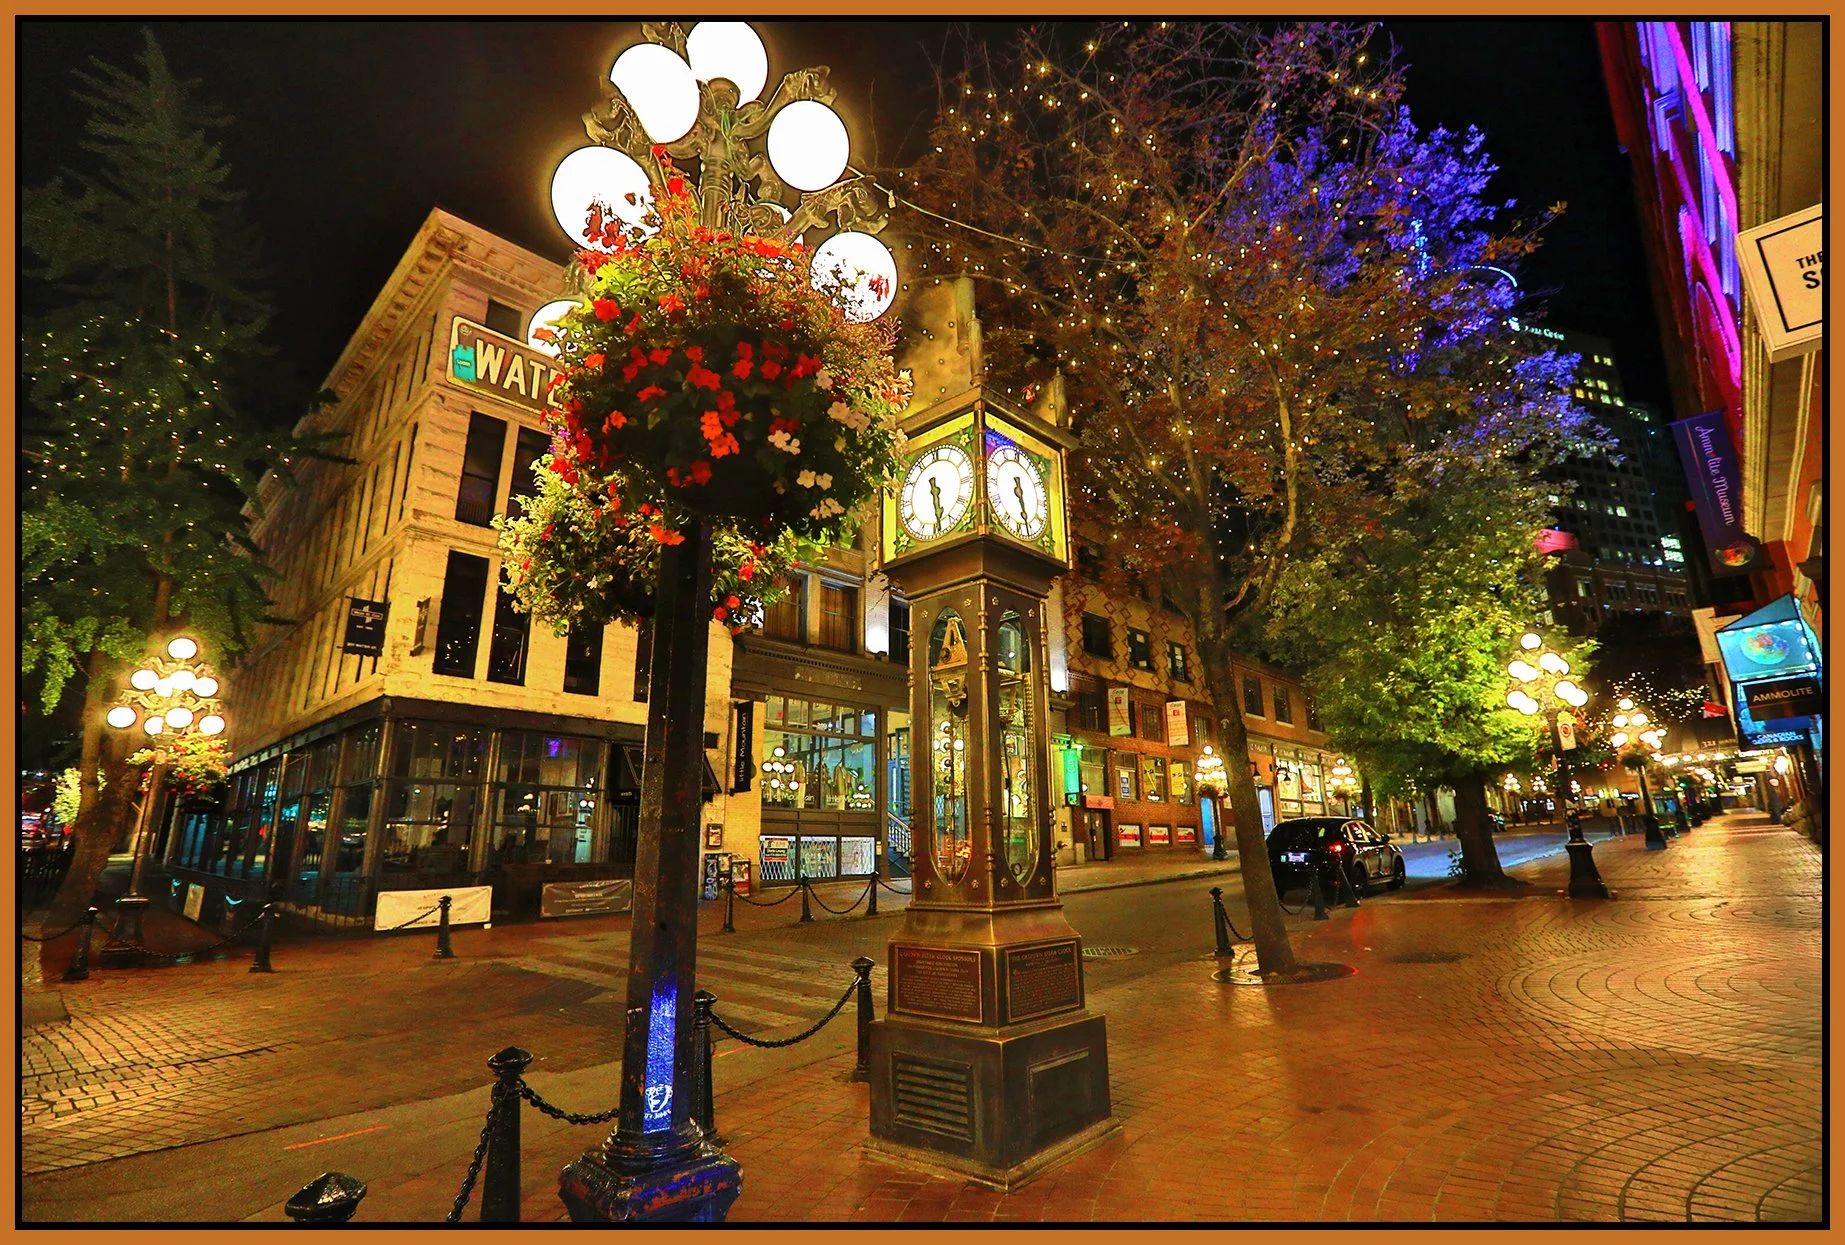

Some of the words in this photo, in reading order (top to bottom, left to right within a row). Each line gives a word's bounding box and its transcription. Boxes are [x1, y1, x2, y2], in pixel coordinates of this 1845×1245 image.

[1802, 269, 1822, 290] S
[1713, 476, 1735, 526] Museum
[1752, 686, 1814, 703] AMMOLITE
[1756, 731, 1797, 740] CANADIAN
